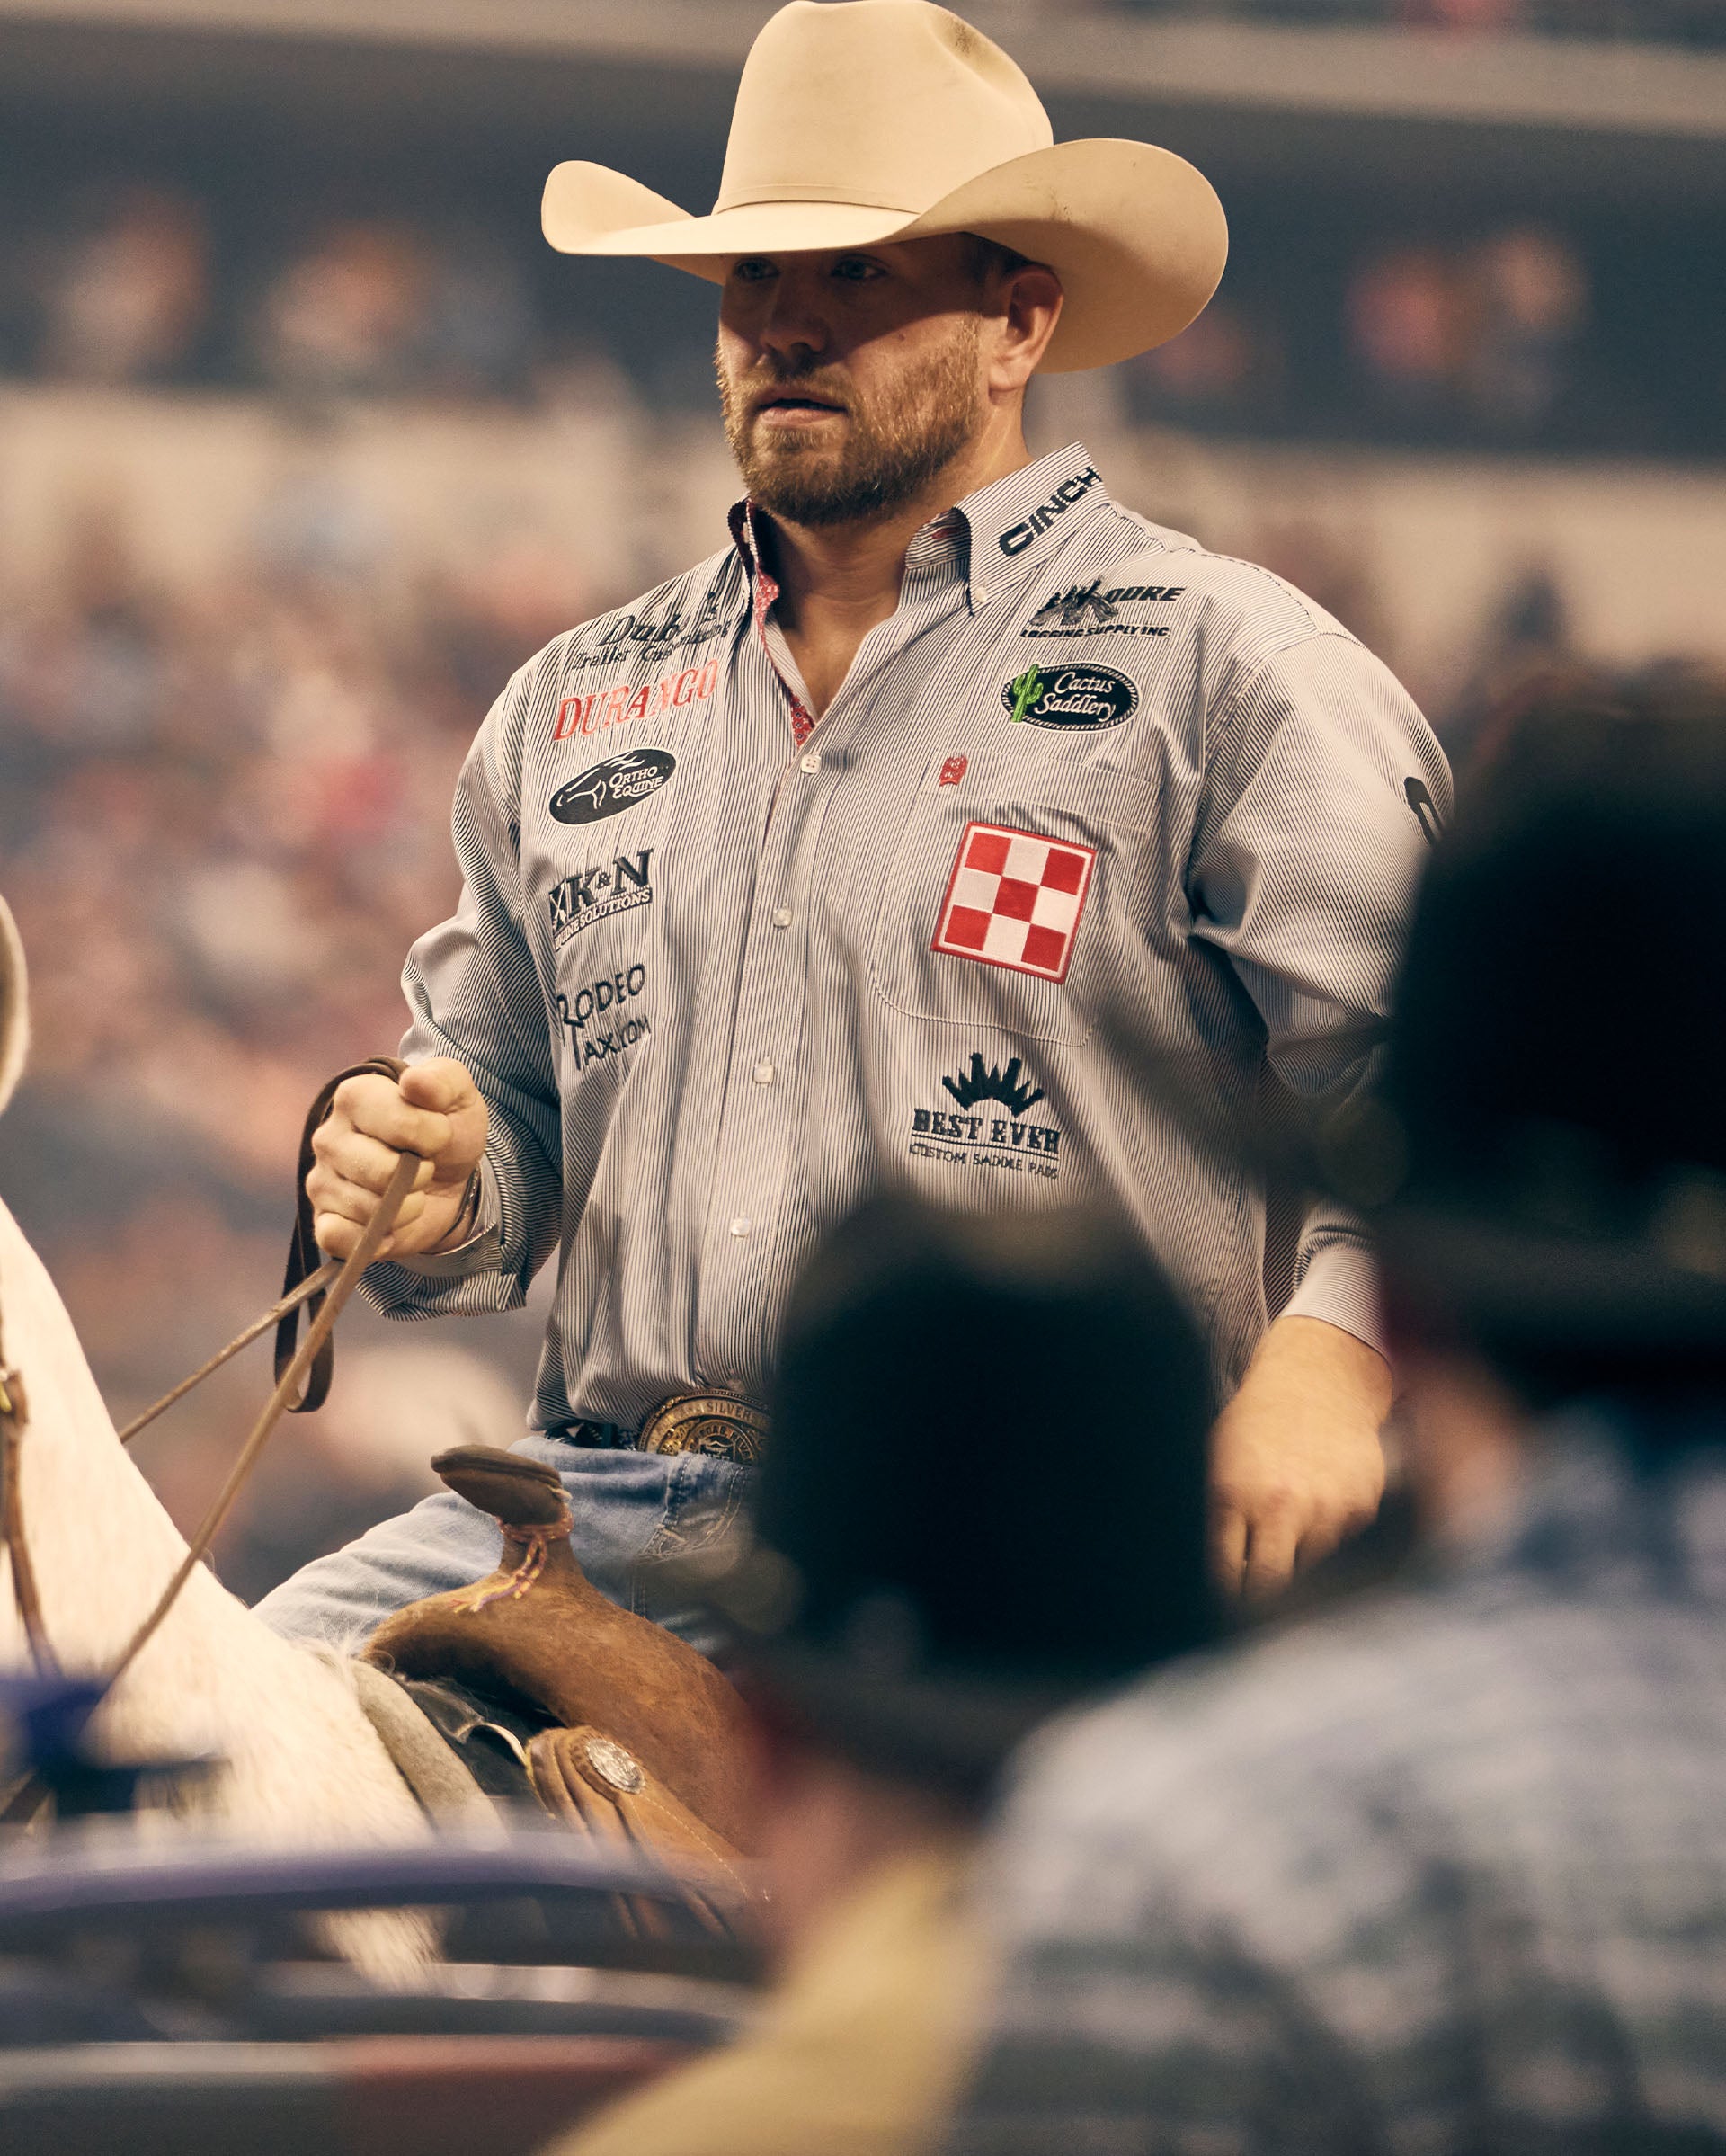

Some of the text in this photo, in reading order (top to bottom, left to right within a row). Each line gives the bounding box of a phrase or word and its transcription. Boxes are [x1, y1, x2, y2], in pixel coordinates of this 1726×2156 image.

[998, 467, 1103, 557] CINCH
[1019, 628, 1084, 638] LOGGING
[1085, 624, 1140, 637] SUPPLY
[572, 646, 630, 670] Trailer
[553, 659, 718, 741] DURANGO
[1054, 672, 1116, 694] Cactus
[1034, 692, 1117, 723] Saddlery
[609, 766, 658, 788] ORTHO
[612, 776, 664, 799] EQUINE
[579, 888, 651, 928] SOLUTIONS
[555, 963, 646, 1043] RODEO
[912, 1108, 1061, 1154] BEST EVER
[909, 1142, 1058, 1180] CUSTOM SADDLE PADS
